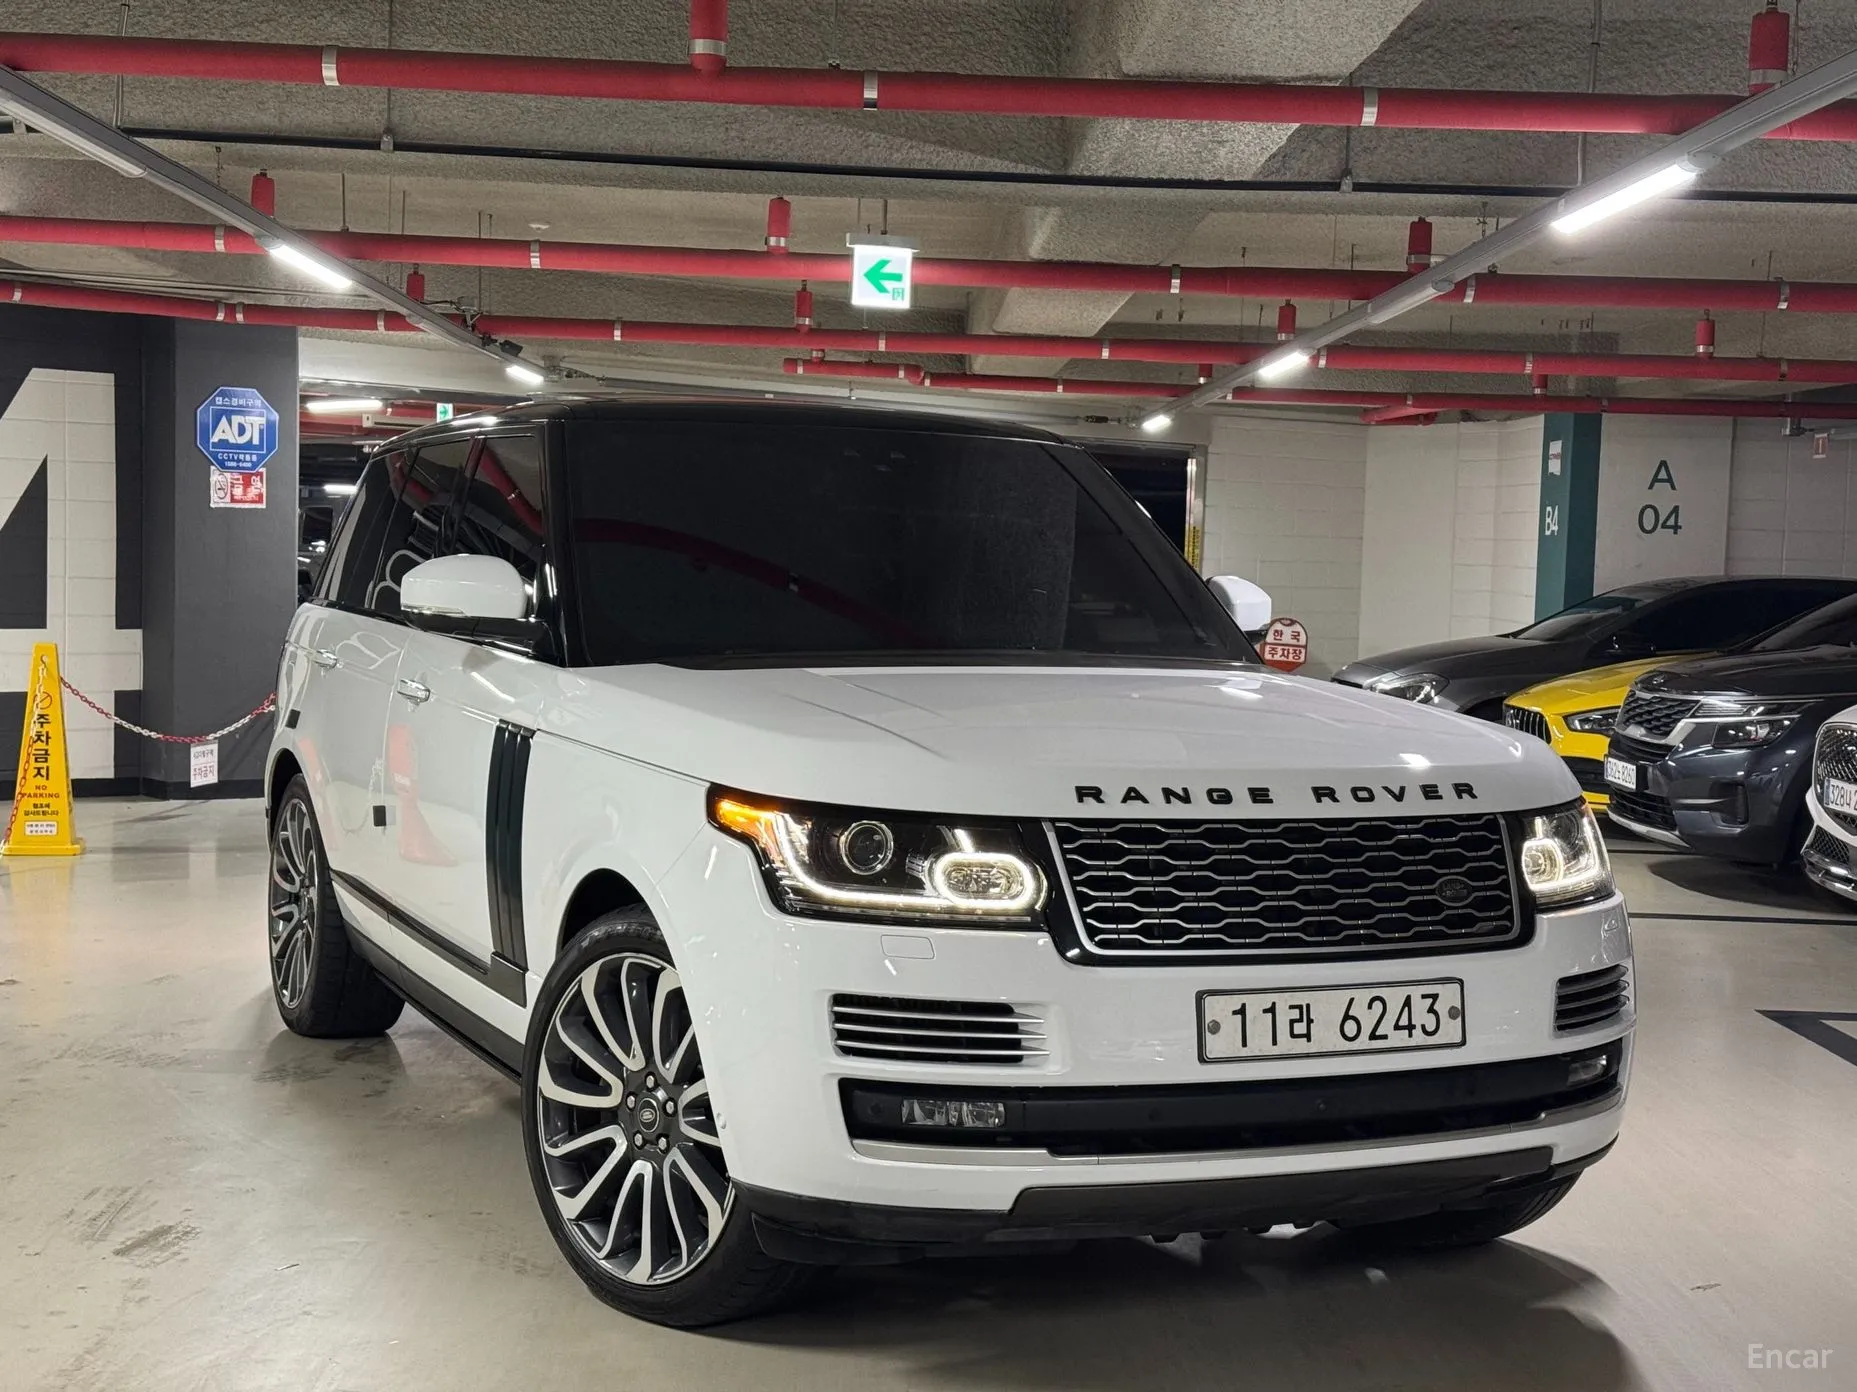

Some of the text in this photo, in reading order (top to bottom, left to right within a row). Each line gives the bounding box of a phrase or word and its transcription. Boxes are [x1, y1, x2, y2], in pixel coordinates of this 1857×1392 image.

[215, 396, 262, 407] 캡스경비구역
[211, 415, 265, 445] ADT
[1647, 459, 1677, 490] A
[1544, 505, 1559, 536] B4
[1638, 504, 1682, 535] 04
[1268, 646, 1302, 660] 주차장
[32, 713, 51, 781] 주차금지
[1075, 782, 1478, 804] RANGE ROVER
[1232, 993, 1441, 1048] 11라 6243
